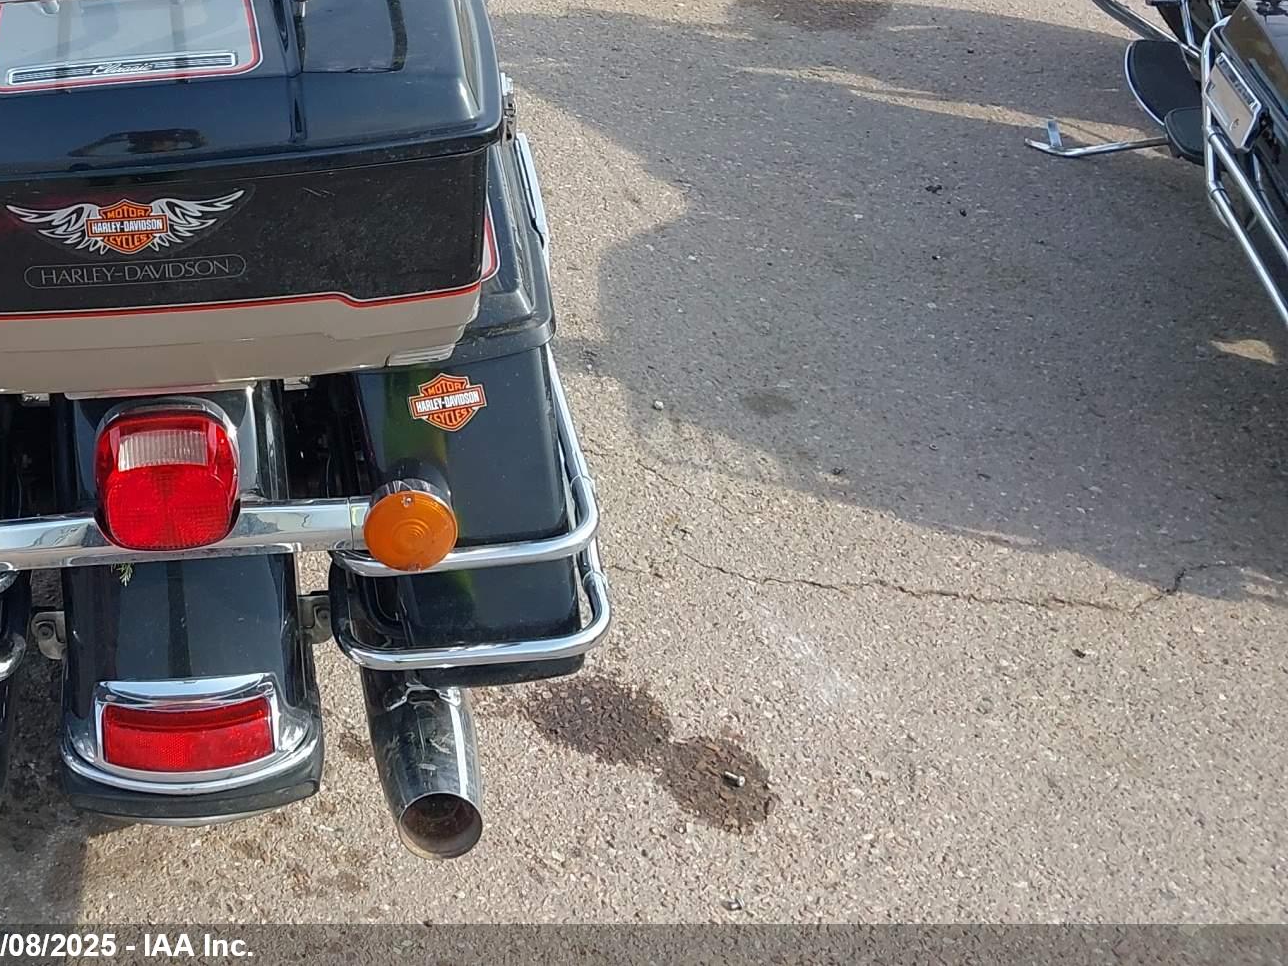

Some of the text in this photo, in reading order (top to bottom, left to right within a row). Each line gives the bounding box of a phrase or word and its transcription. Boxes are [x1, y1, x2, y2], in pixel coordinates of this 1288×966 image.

[106, 205, 146, 219] MOTOR
[91, 218, 164, 234] HARLEY-DAVIDSON
[109, 233, 148, 249] CYCLES
[41, 259, 230, 286] HARLEY-DAVIDSON
[427, 380, 462, 396] MOTOR
[415, 391, 480, 413] HARLEY-DAVIDSON
[433, 409, 468, 426] CYCLES
